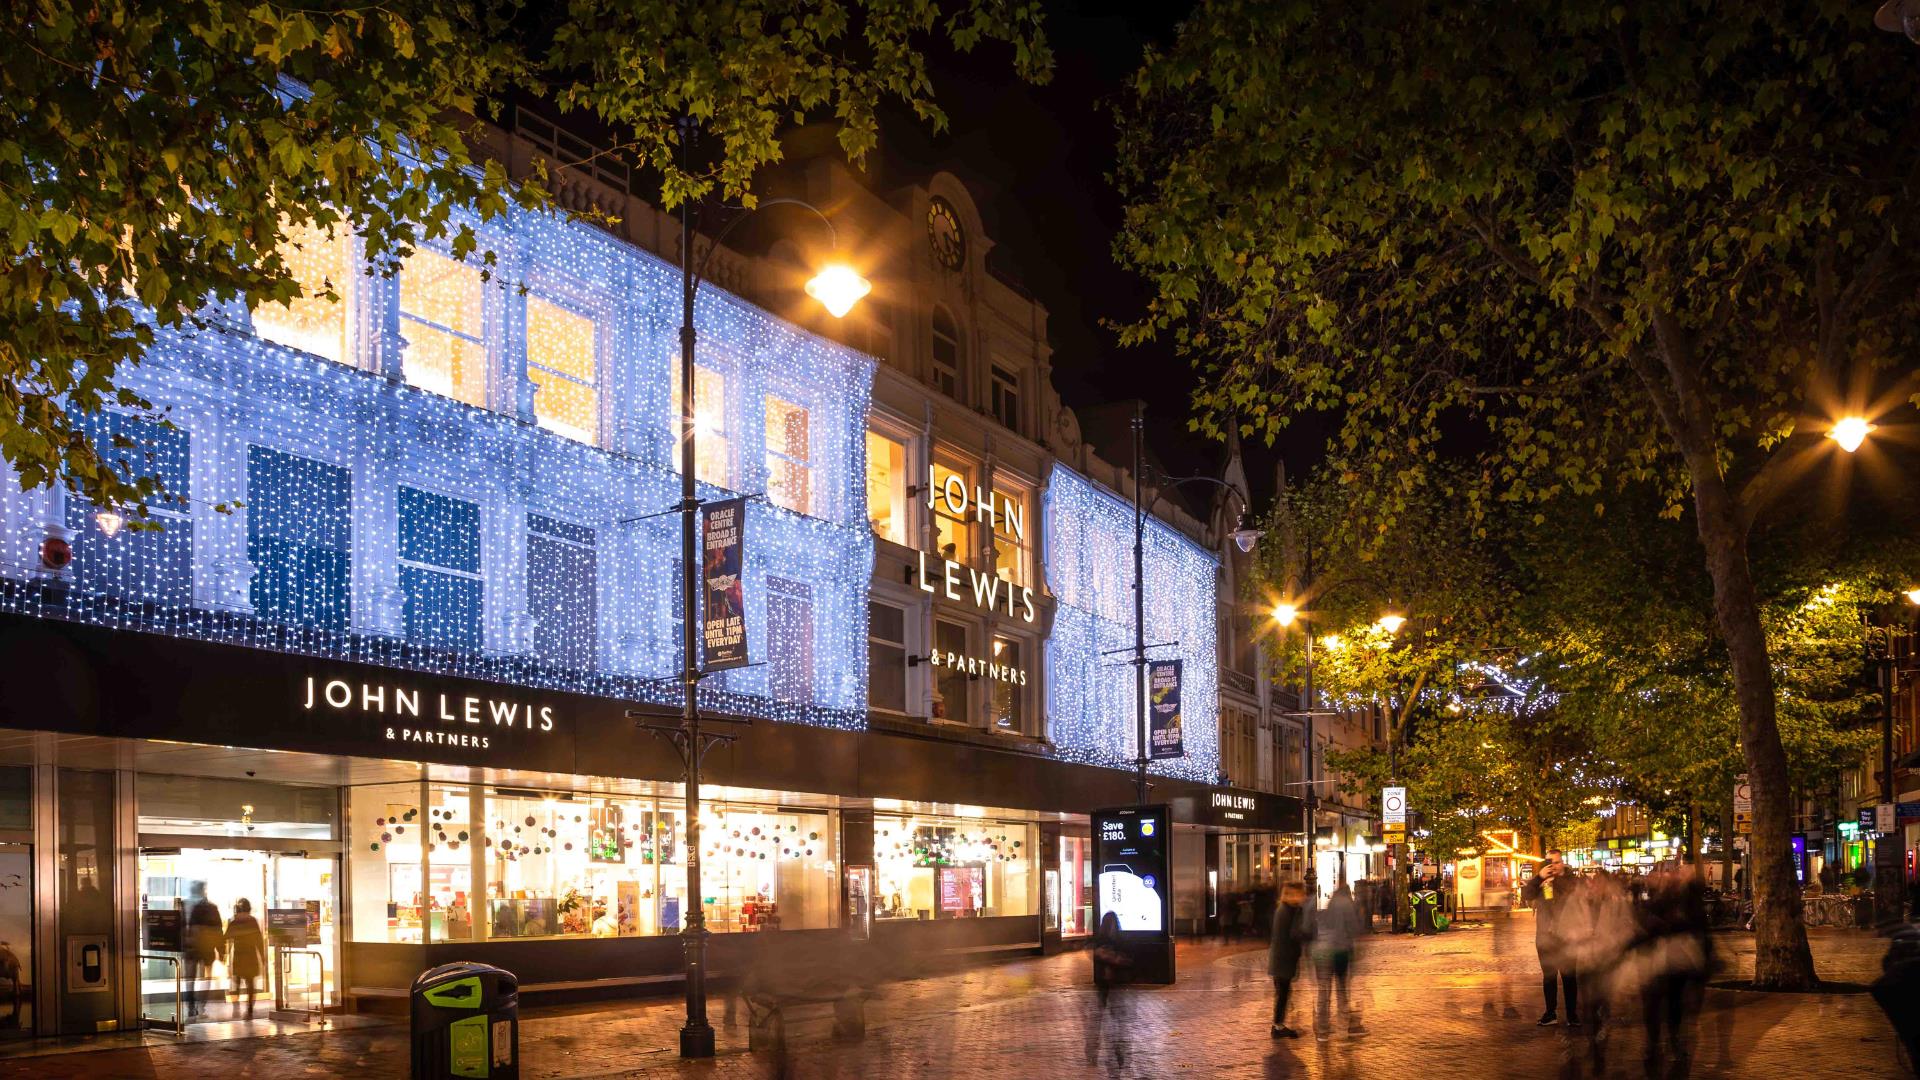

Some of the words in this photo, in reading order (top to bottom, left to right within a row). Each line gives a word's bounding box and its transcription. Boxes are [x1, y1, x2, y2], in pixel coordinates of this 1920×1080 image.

[927, 464, 1023, 539] JOHN
[710, 508, 735, 520] ORACLE
[710, 518, 734, 530] CENTRE
[706, 530, 729, 541] BROAD
[730, 527, 737, 537] ST
[706, 536, 737, 550] ENTRANCE
[919, 551, 1035, 623] LEWIS
[706, 618, 725, 630] OPEN
[726, 616, 741, 627] LATE
[705, 629, 724, 640] UNTIL
[726, 625, 743, 636] 11PM
[707, 634, 741, 648] EVERYDAY
[931, 648, 940, 666] &
[947, 652, 1026, 686] PARTNERS
[304, 677, 419, 717] JOHN
[440, 694, 554, 731] LEWIS
[386, 727, 395, 740] &
[402, 728, 490, 749] PARTNERS
[1212, 793, 1232, 807] JOHN
[1233, 796, 1255, 810] LEWIS
[1102, 821, 1124, 831] Save
[1103, 831, 1126, 840] £180.
